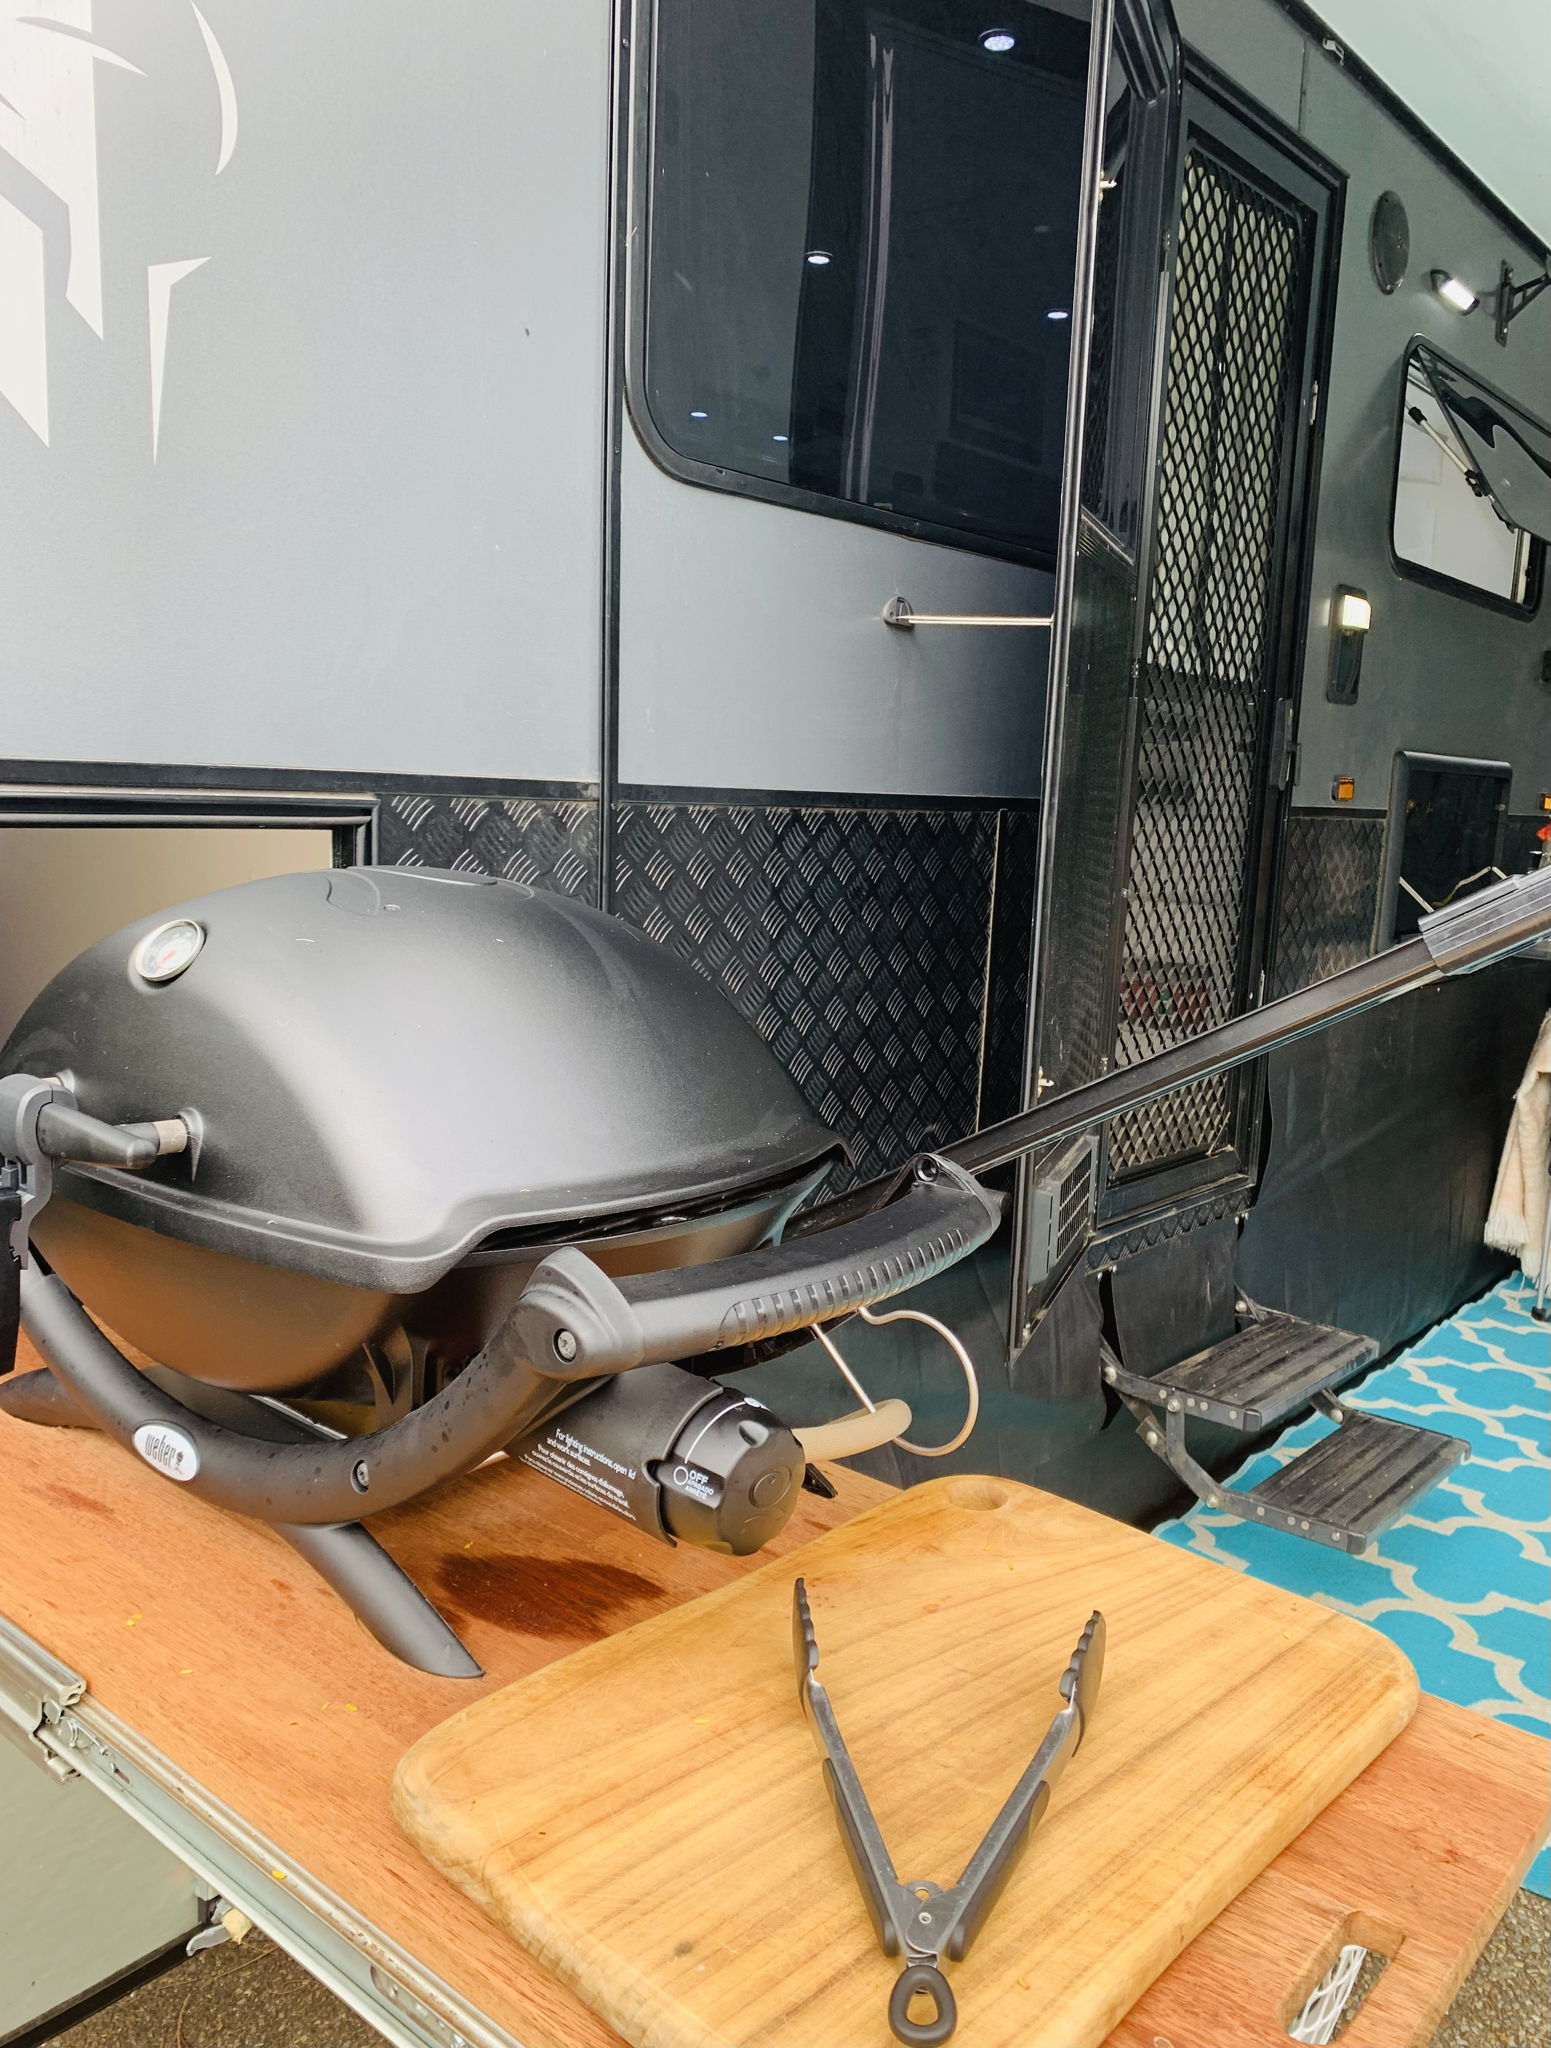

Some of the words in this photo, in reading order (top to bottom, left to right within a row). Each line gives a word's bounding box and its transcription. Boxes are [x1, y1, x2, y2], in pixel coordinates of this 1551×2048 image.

[145, 1433, 177, 1468] weber
[556, 1428, 566, 1441] For
[627, 1468, 637, 1480] lid
[690, 1470, 709, 1484] OFF
